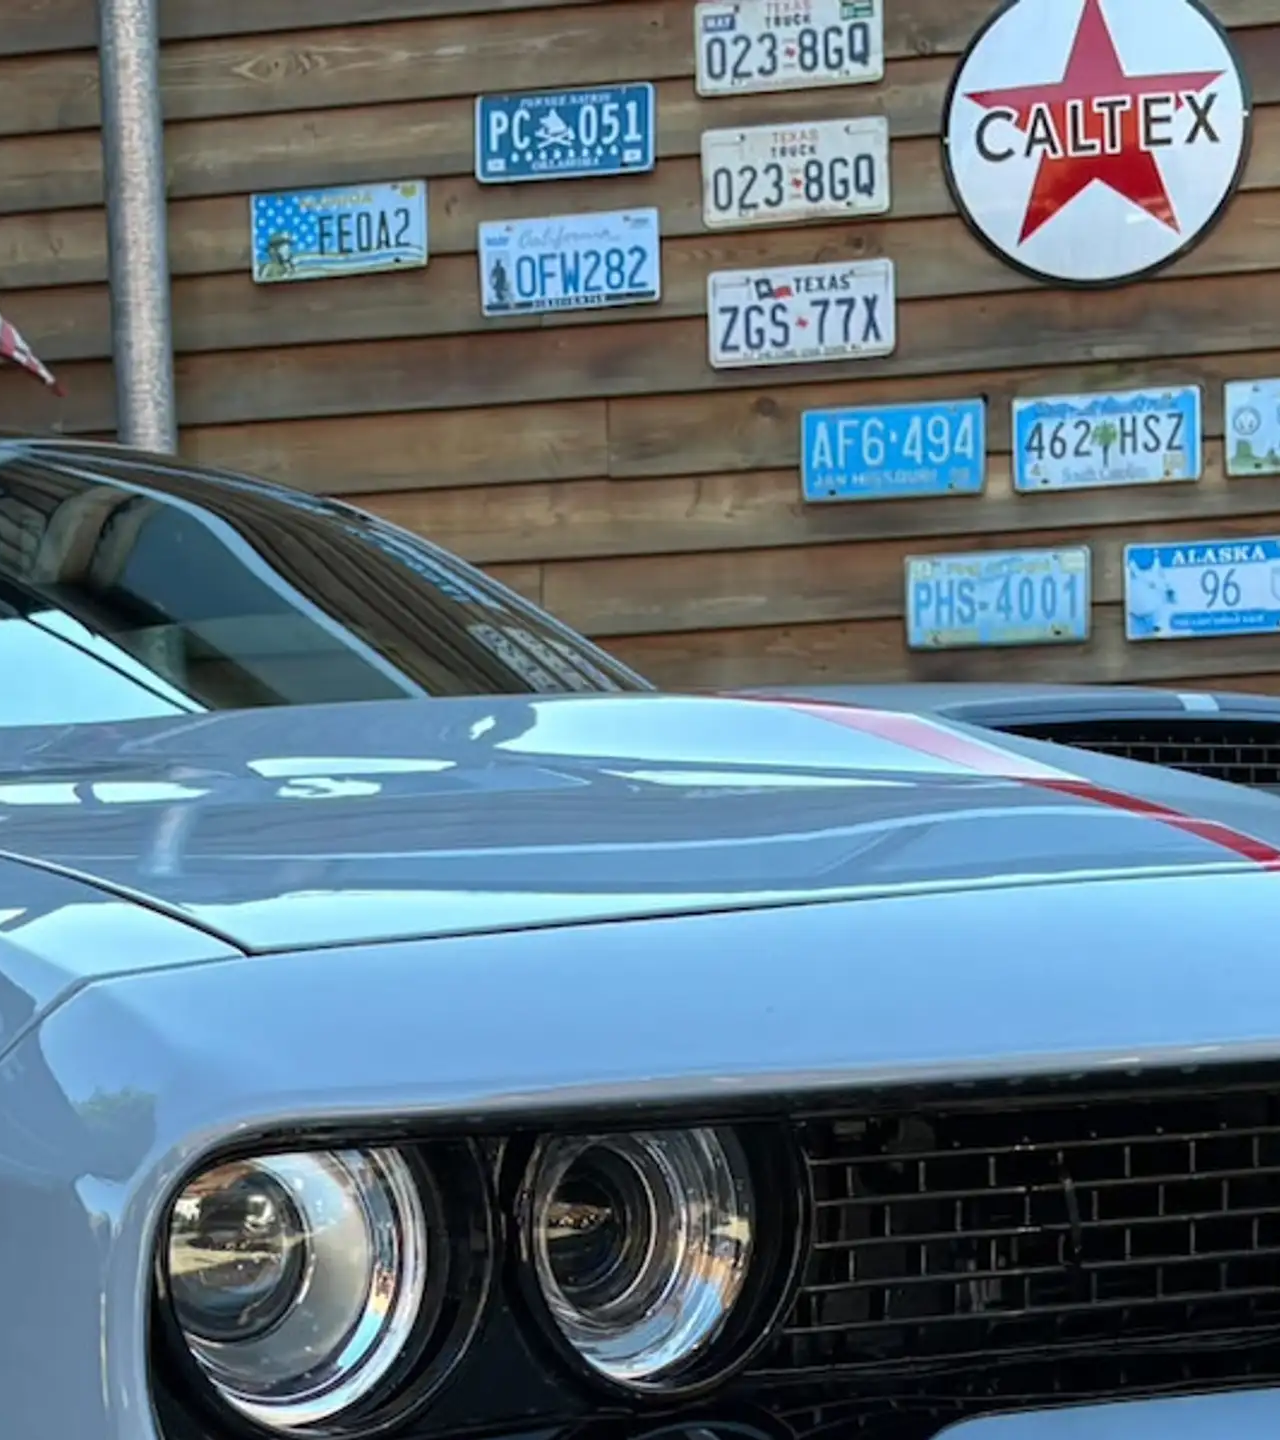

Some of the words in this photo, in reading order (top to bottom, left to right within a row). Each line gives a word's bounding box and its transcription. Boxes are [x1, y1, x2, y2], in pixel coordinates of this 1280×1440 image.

[706, 32, 778, 80] 023
[798, 22, 870, 72] 8GQ
[489, 109, 531, 152] PC
[578, 100, 642, 146] 051
[975, 92, 1221, 163] CALTEX
[713, 163, 784, 212] 023
[803, 153, 875, 203] 8GQ
[793, 273, 851, 294] TEXAS
[718, 302, 790, 352] ZGS
[810, 294, 882, 344] 77X
[1024, 419, 1091, 460] 462
[1171, 545, 1267, 565] ALASKA
[1200, 568, 1241, 608] 96
